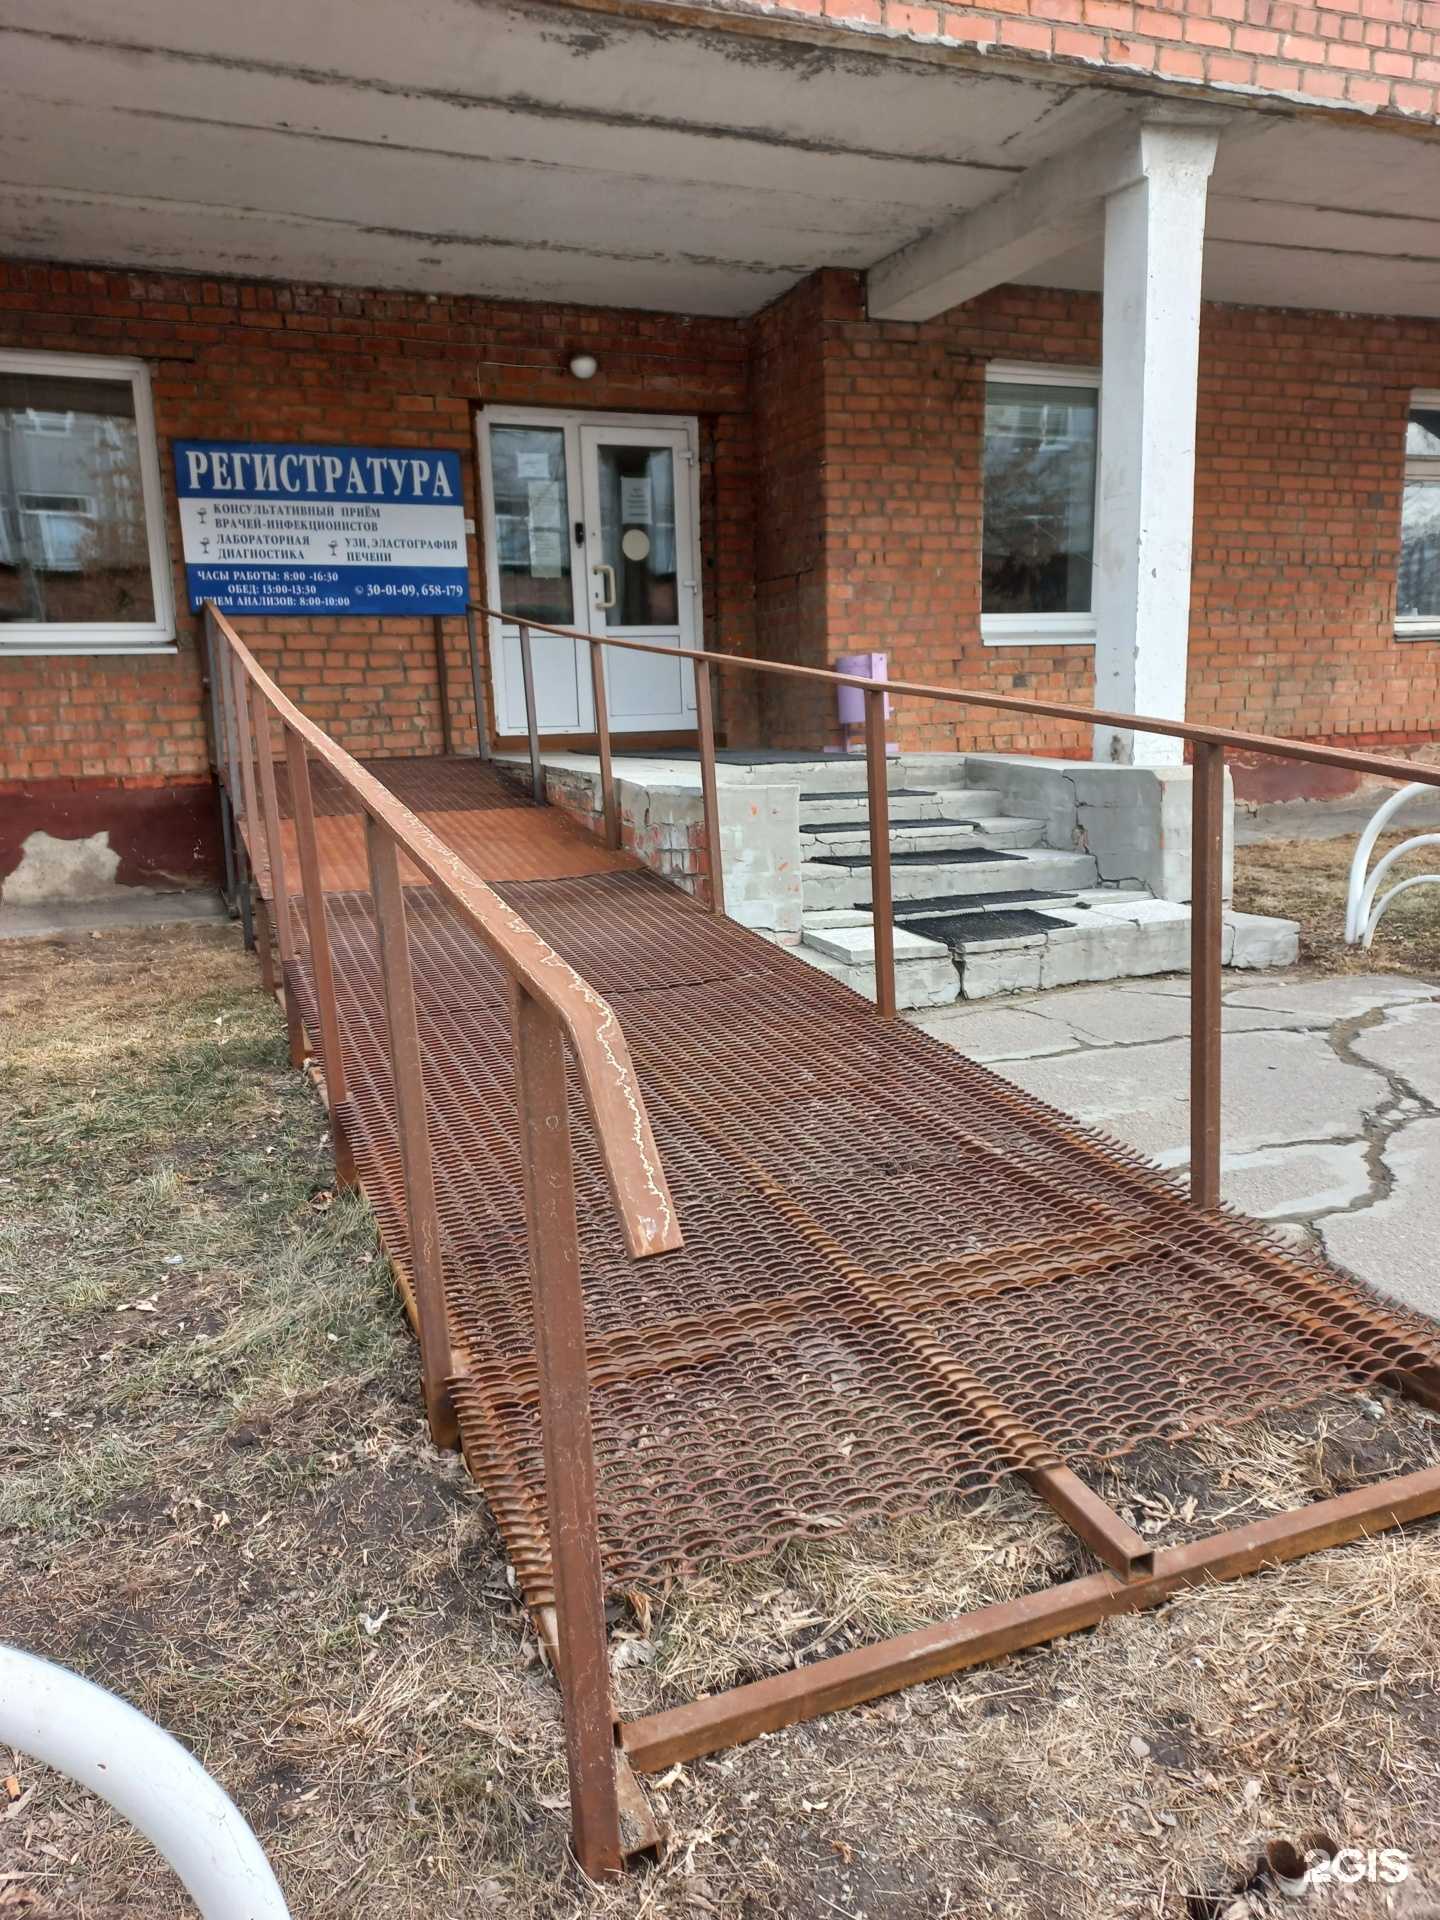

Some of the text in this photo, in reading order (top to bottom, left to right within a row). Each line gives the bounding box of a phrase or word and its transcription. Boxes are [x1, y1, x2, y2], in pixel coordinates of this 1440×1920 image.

[185, 451, 453, 497] РЕГИСТРАТУРА
[213, 503, 381, 518] КОНСУЛЬТАТИВНЫЙ ПРИЁМ
[215, 518, 379, 532] ВРАЧЕЙ-ИНФЕКЦИОНИСТОВ
[216, 534, 310, 546] ЛАБОРАТОРНАЯ
[218, 548, 305, 560] ДИАГНОСТИКА
[347, 551, 392, 562] ПЕЧЕНИ
[197, 570, 229, 581] ЧАСЫ
[233, 570, 280, 581] РАБОТЫ:
[283, 571, 306, 581] 8:00
[227, 584, 260, 595] ОБЕД:
[237, 596, 297, 606] АНАЛИЗОВ:
[299, 596, 351, 607] 8:00-10:00
